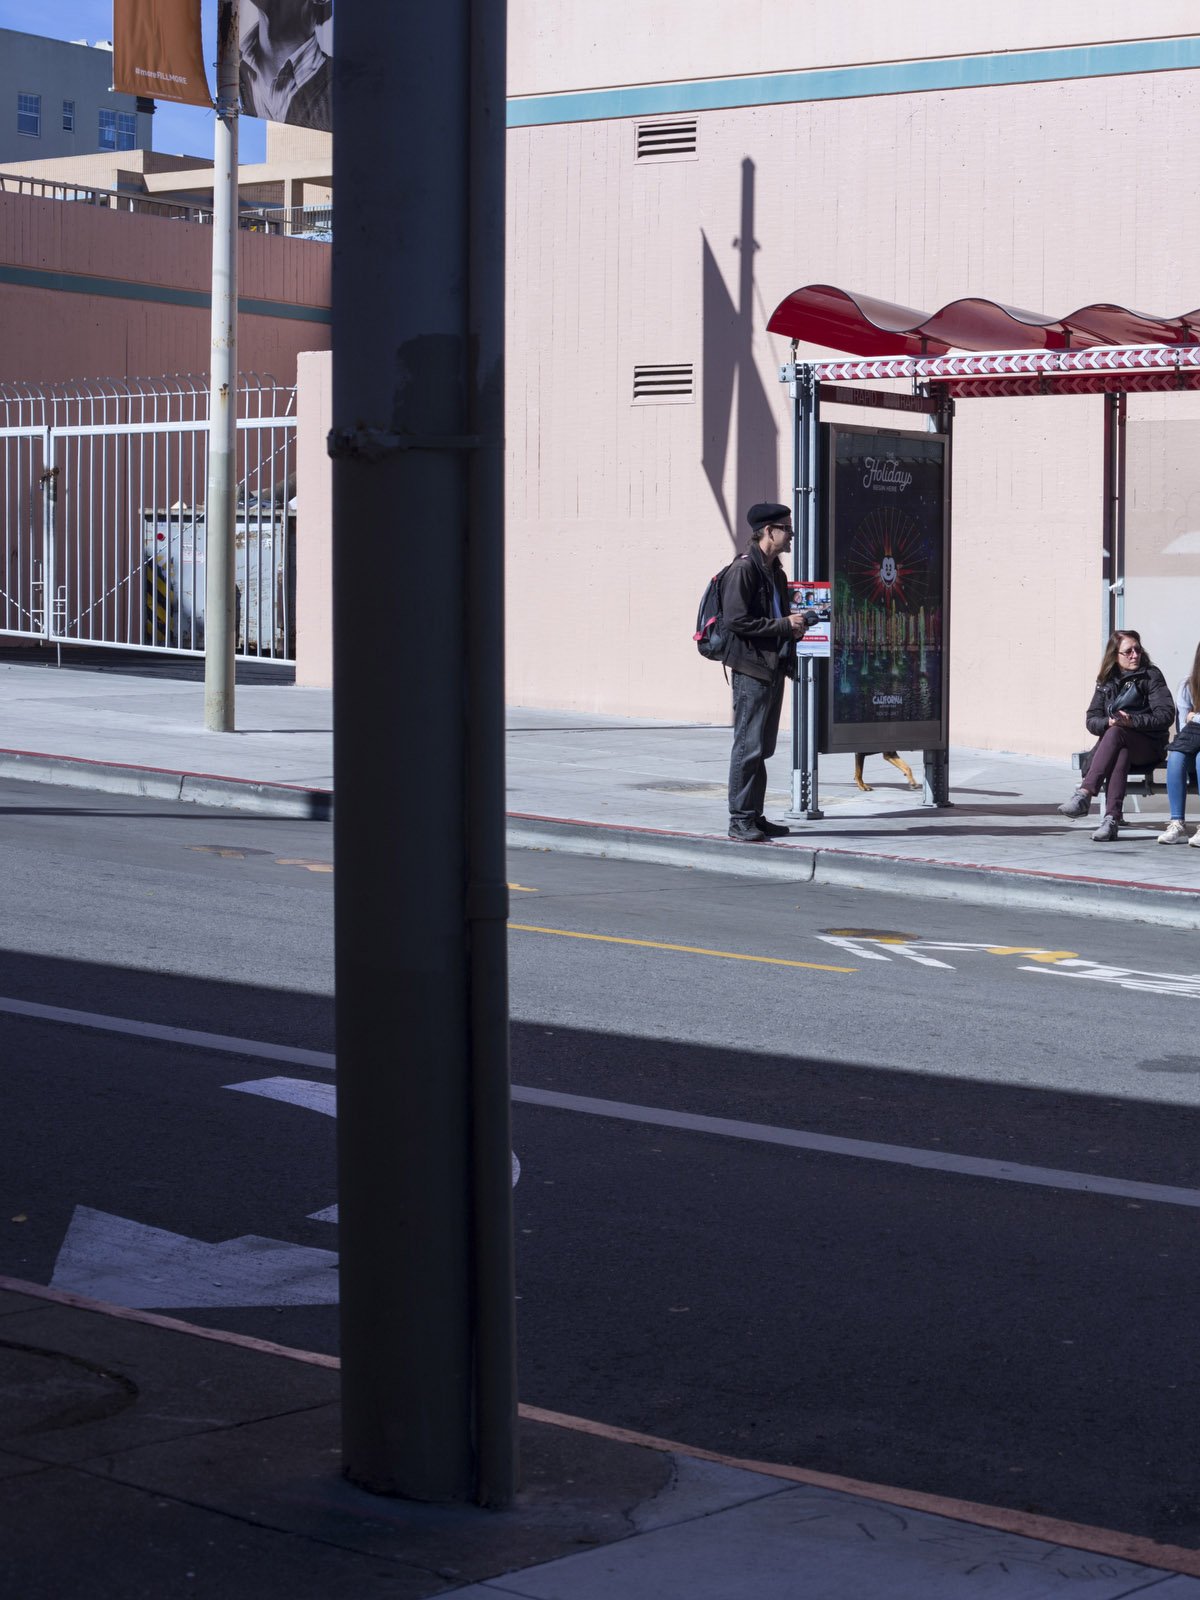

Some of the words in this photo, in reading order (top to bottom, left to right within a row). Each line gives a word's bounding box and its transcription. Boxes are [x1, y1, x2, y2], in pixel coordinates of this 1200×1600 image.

[853, 388, 877, 406] RAPID
[900, 394, 923, 411] RAPID
[863, 456, 912, 492] Holidays
